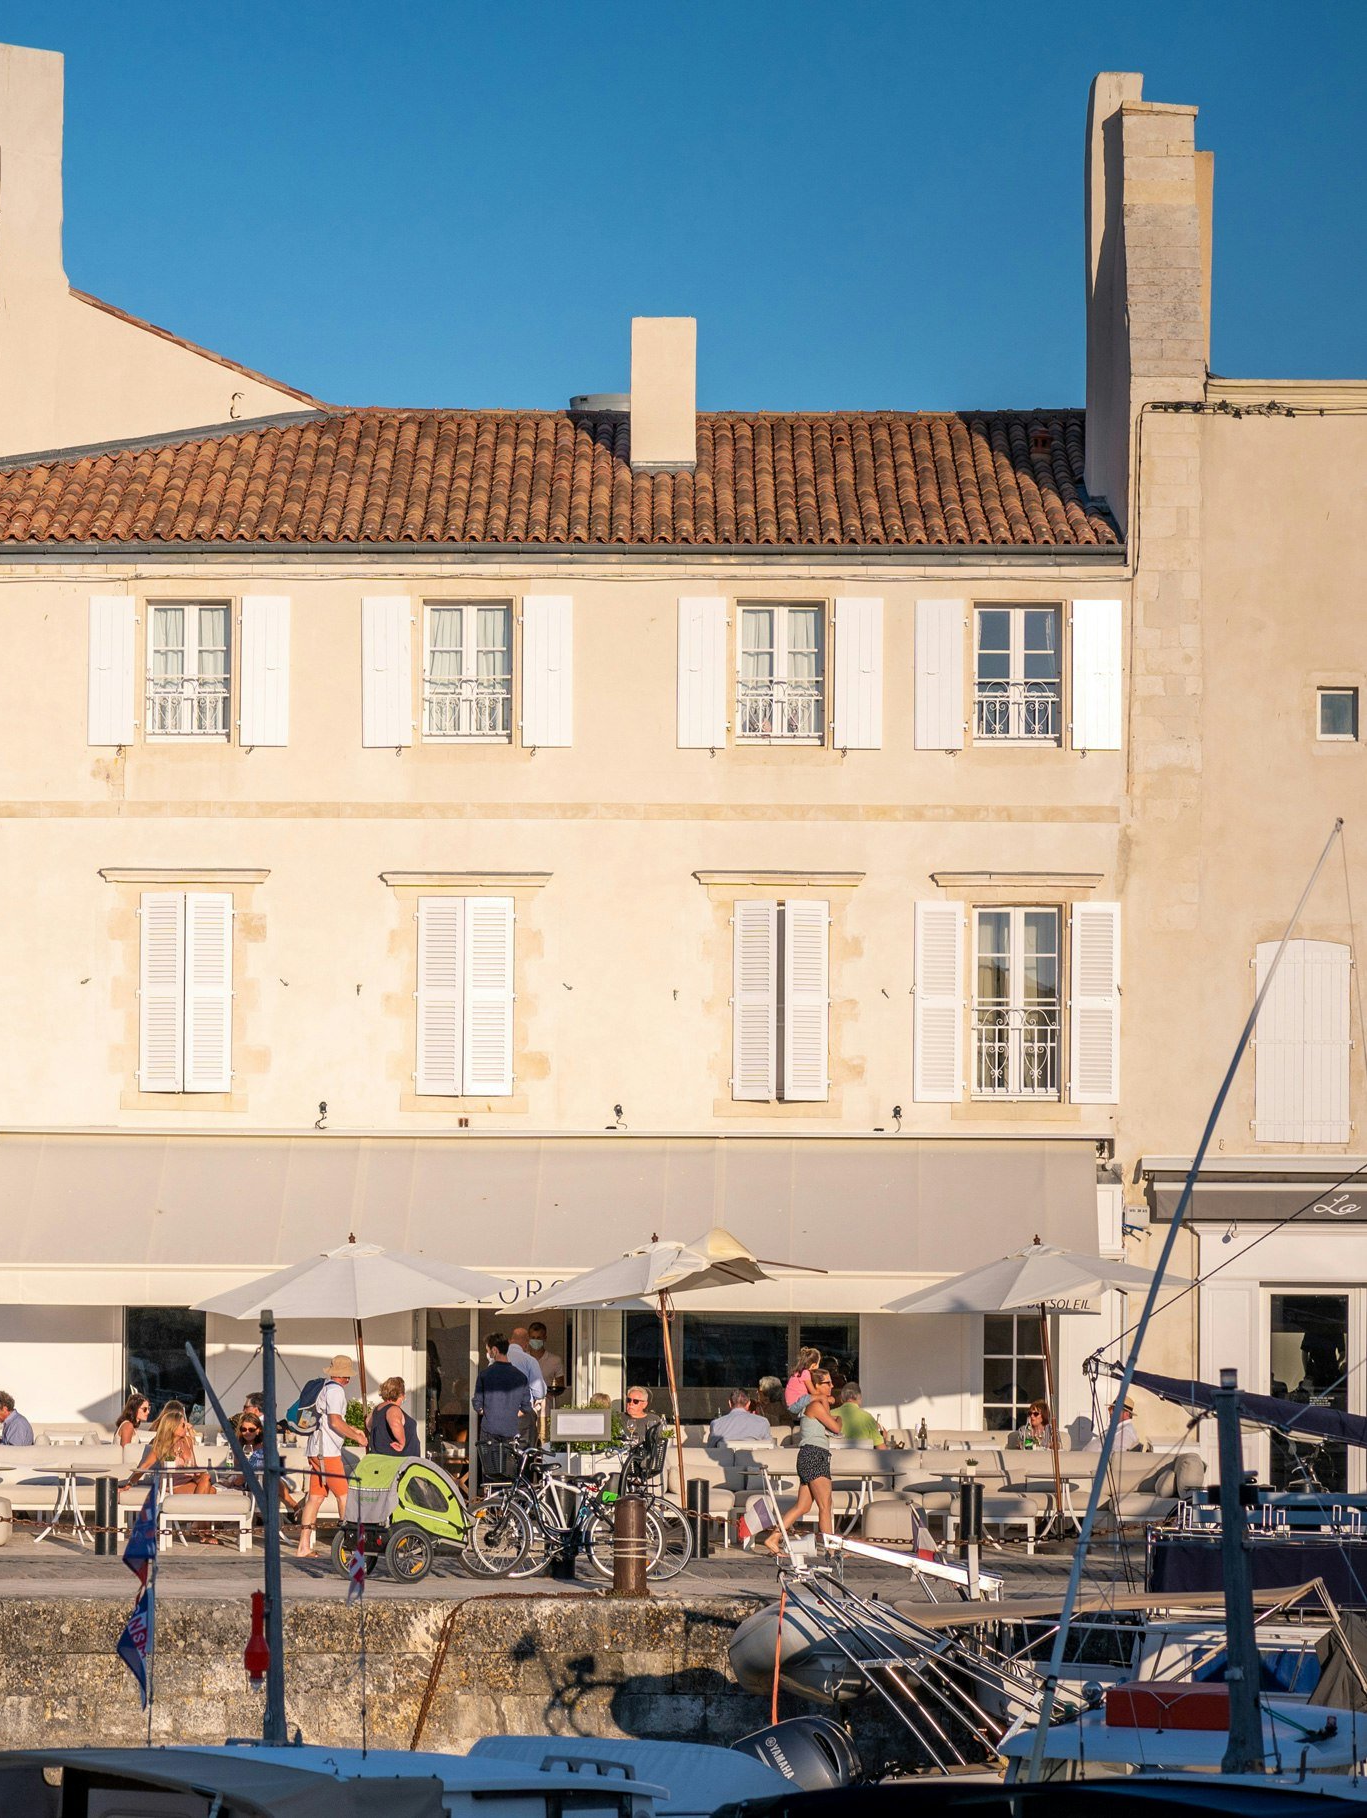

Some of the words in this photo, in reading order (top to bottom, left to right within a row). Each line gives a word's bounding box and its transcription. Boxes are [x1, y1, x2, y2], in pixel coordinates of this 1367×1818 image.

[1313, 1194, 1362, 1216] La
[1049, 1299, 1091, 1310] SOLEIL
[770, 1743, 795, 1780] YAMAHA
